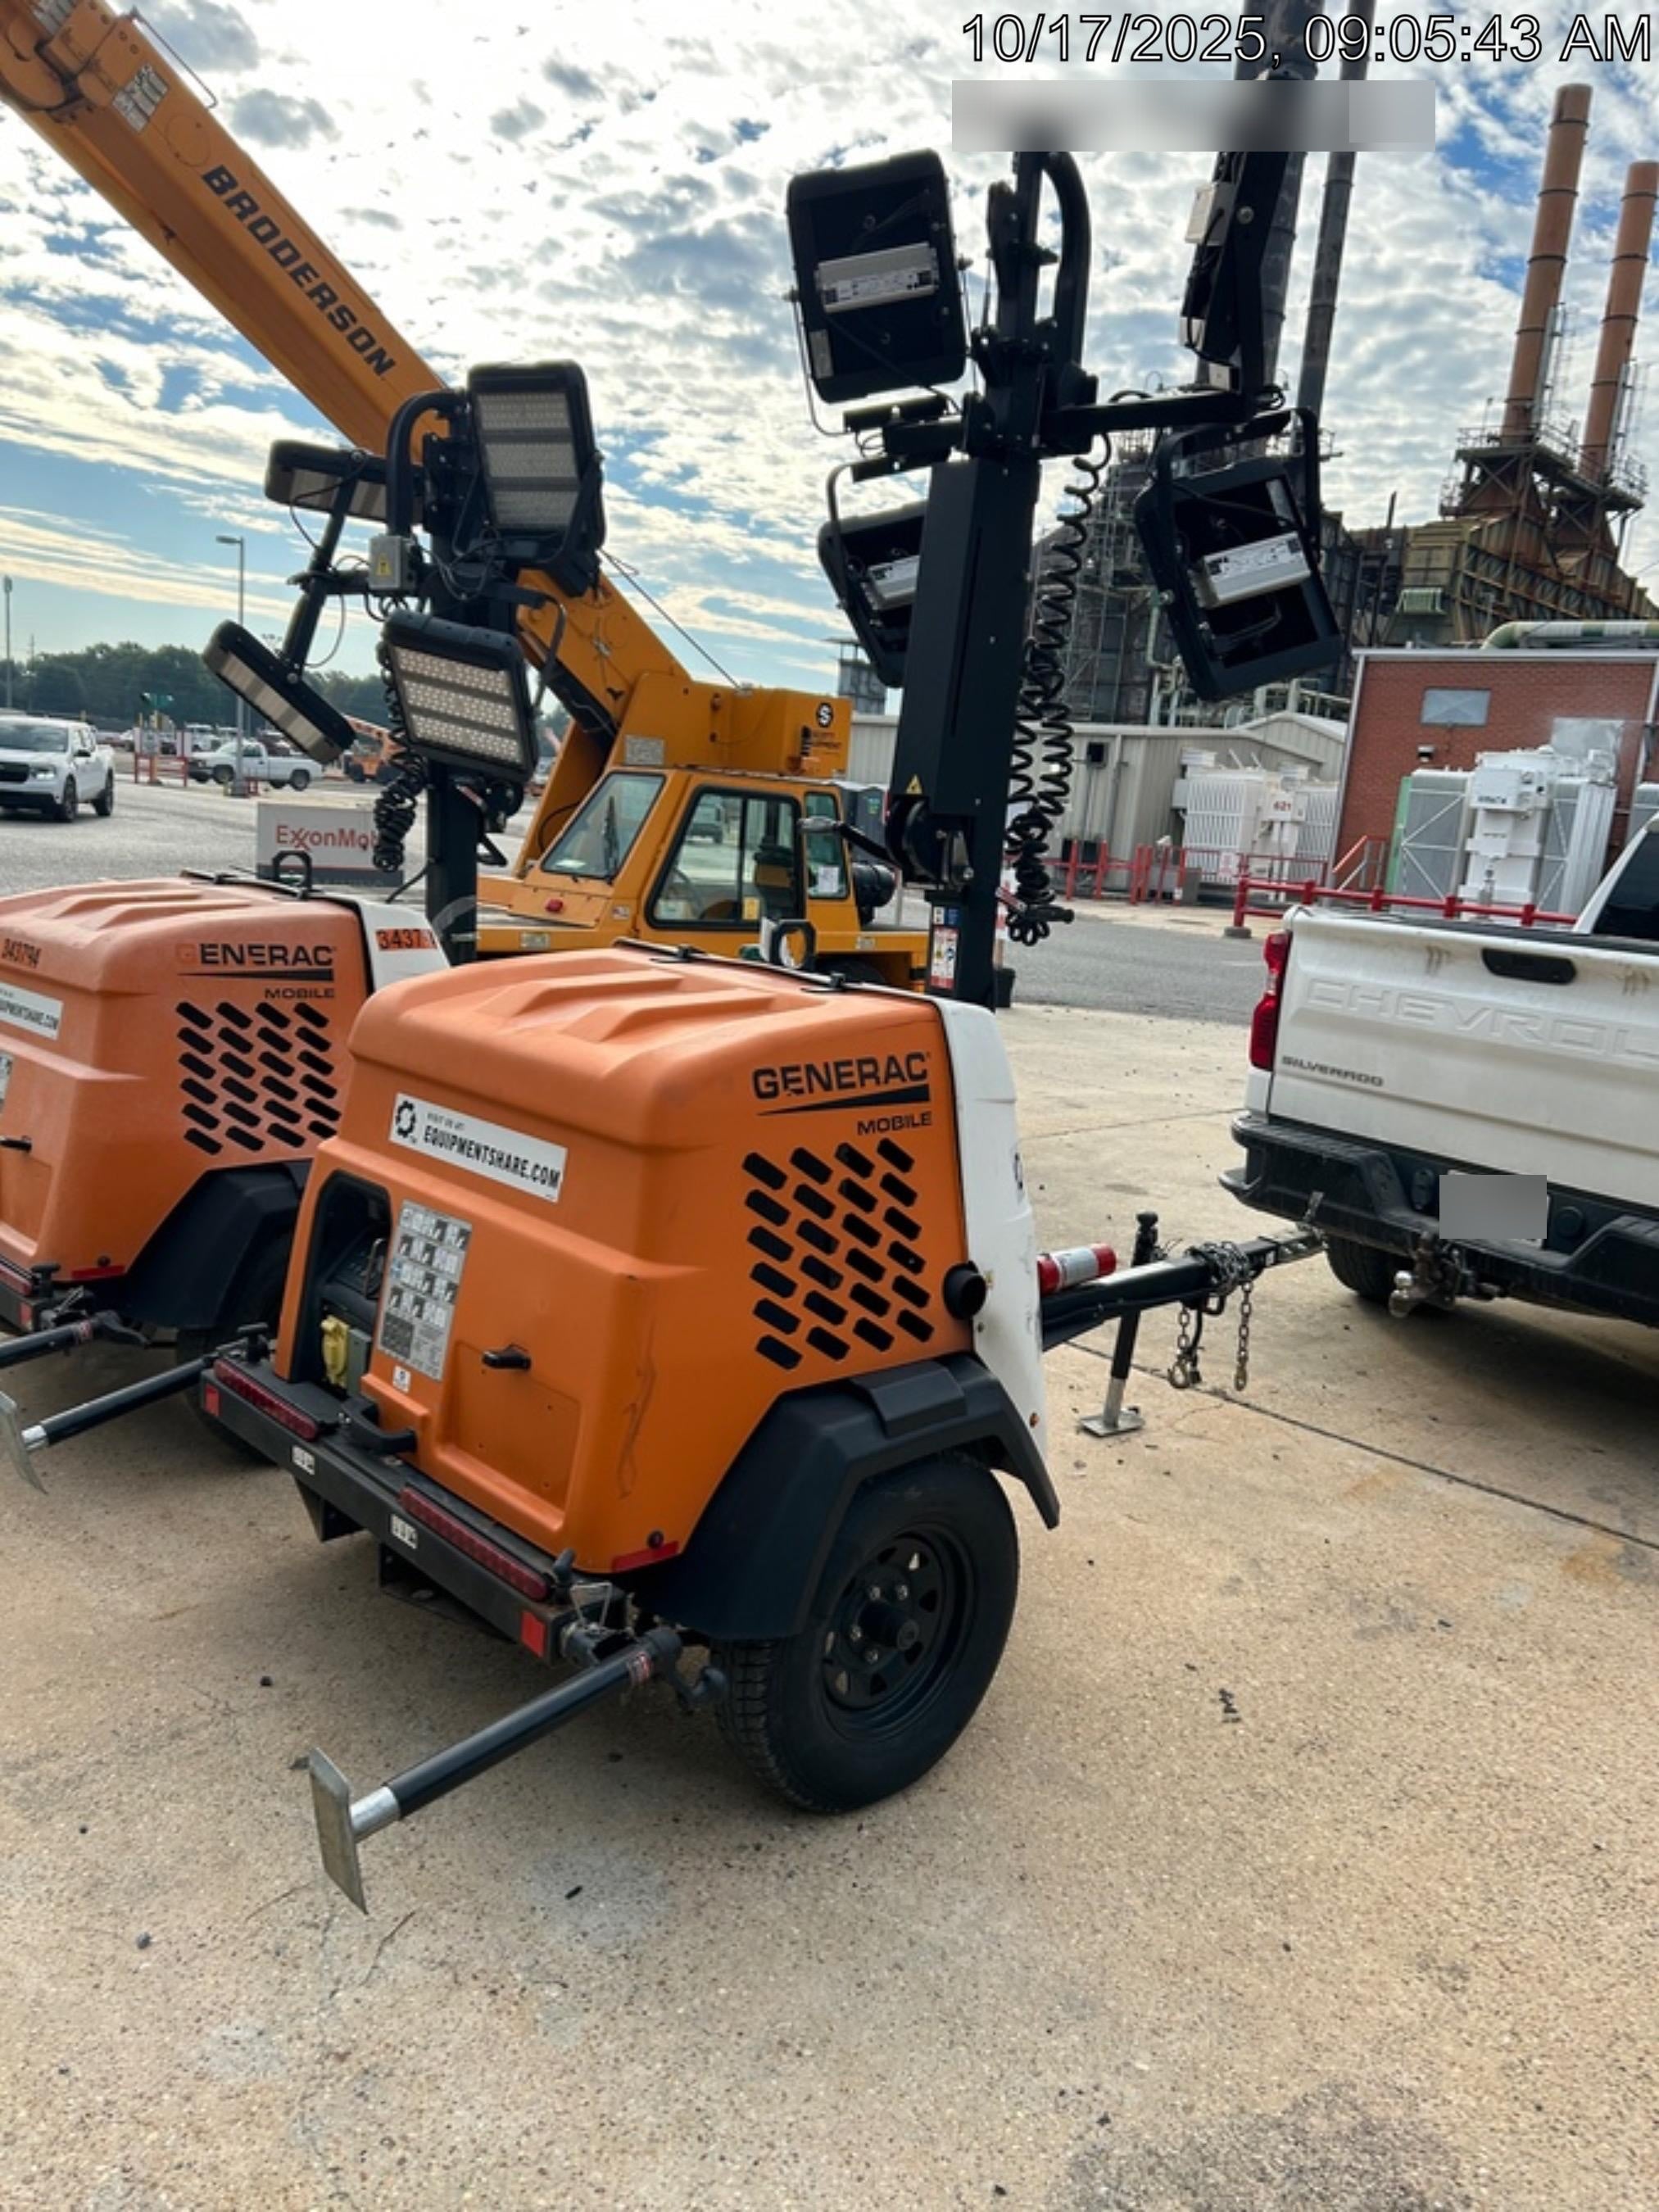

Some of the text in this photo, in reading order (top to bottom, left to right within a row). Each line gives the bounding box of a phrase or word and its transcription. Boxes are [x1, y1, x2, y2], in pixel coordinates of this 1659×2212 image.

[202, 165, 396, 376] BRODERSON
[265, 987, 335, 999] MOBILE
[753, 1052, 929, 1099] GENERAC
[1281, 1054, 1383, 1087] SILVERADO
[857, 1111, 931, 1135] MOBILE
[424, 1125, 561, 1188] EQUIPMENTSHARE.COM
